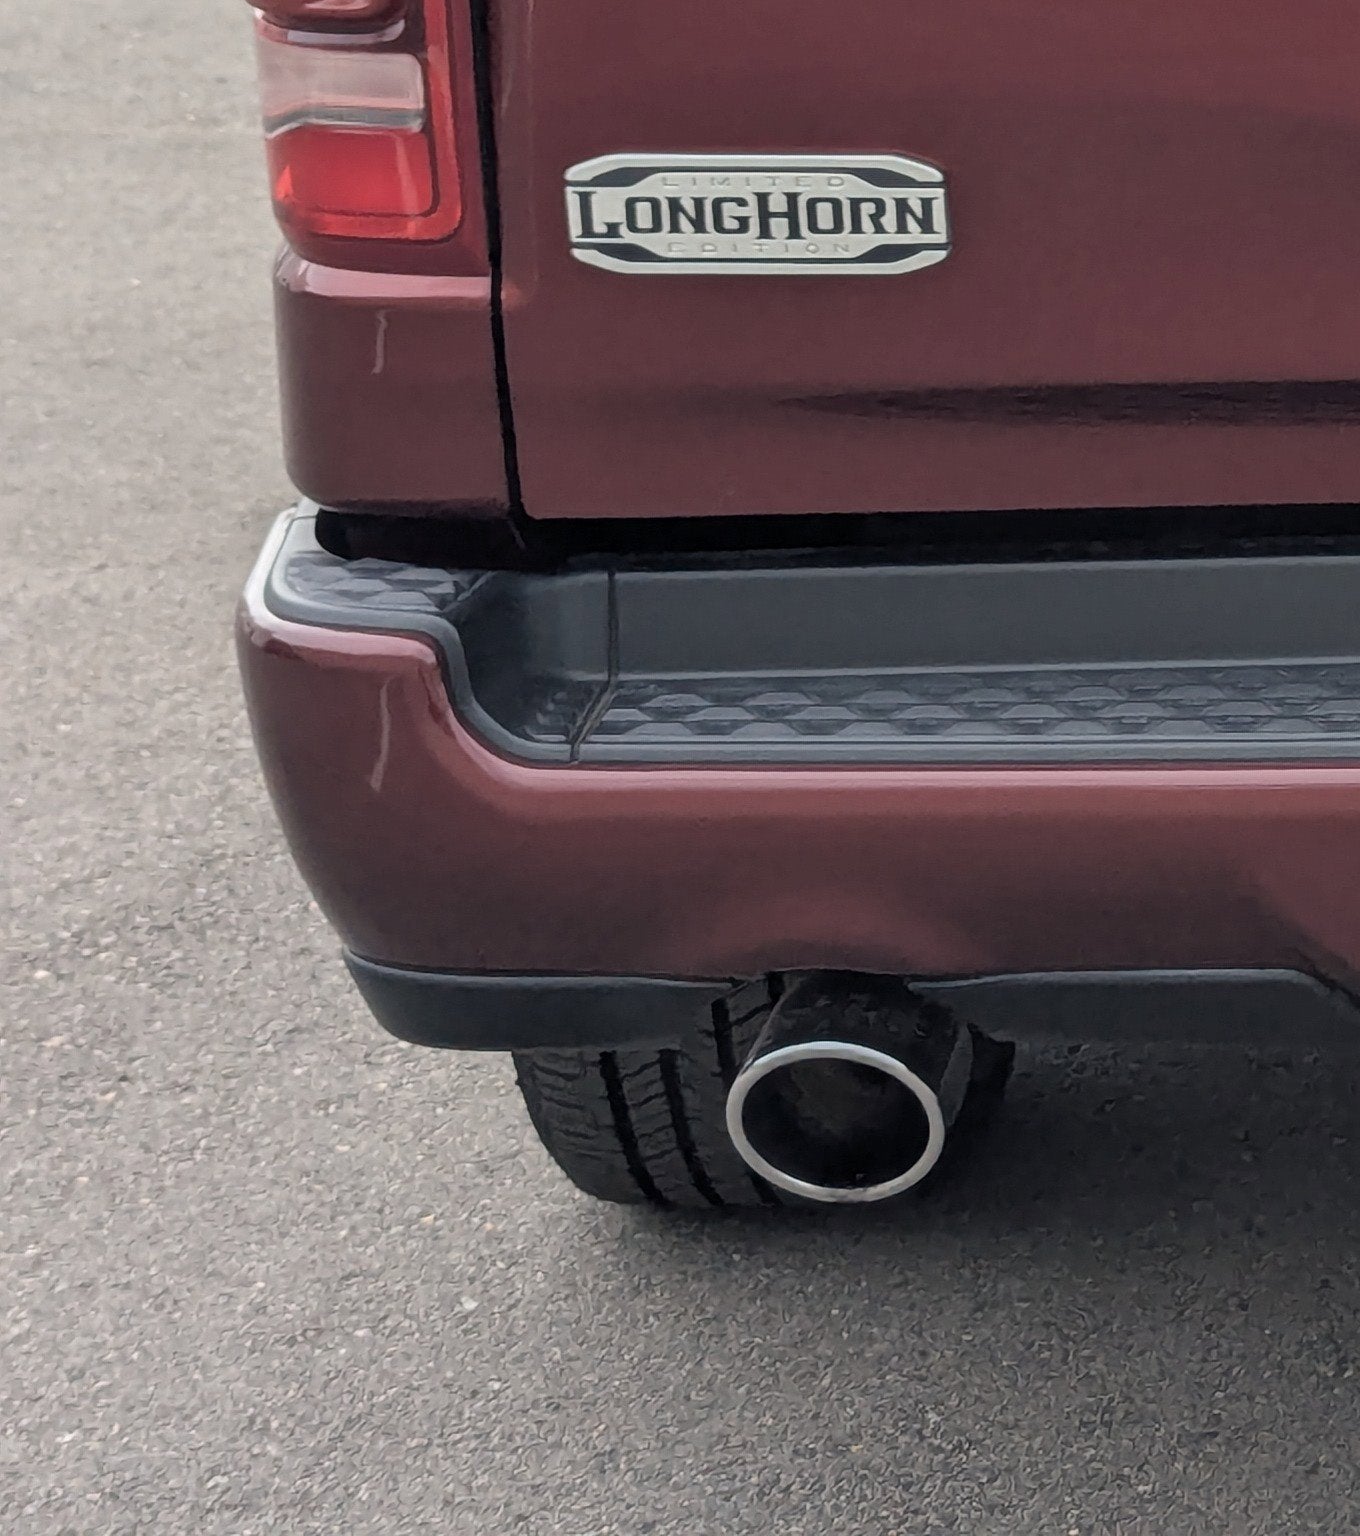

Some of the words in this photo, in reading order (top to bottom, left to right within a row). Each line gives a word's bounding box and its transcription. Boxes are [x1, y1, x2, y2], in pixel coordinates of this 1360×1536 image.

[660, 175, 847, 189] LIMITED
[575, 190, 942, 240] LONGHORN
[667, 241, 852, 254] EDITION
